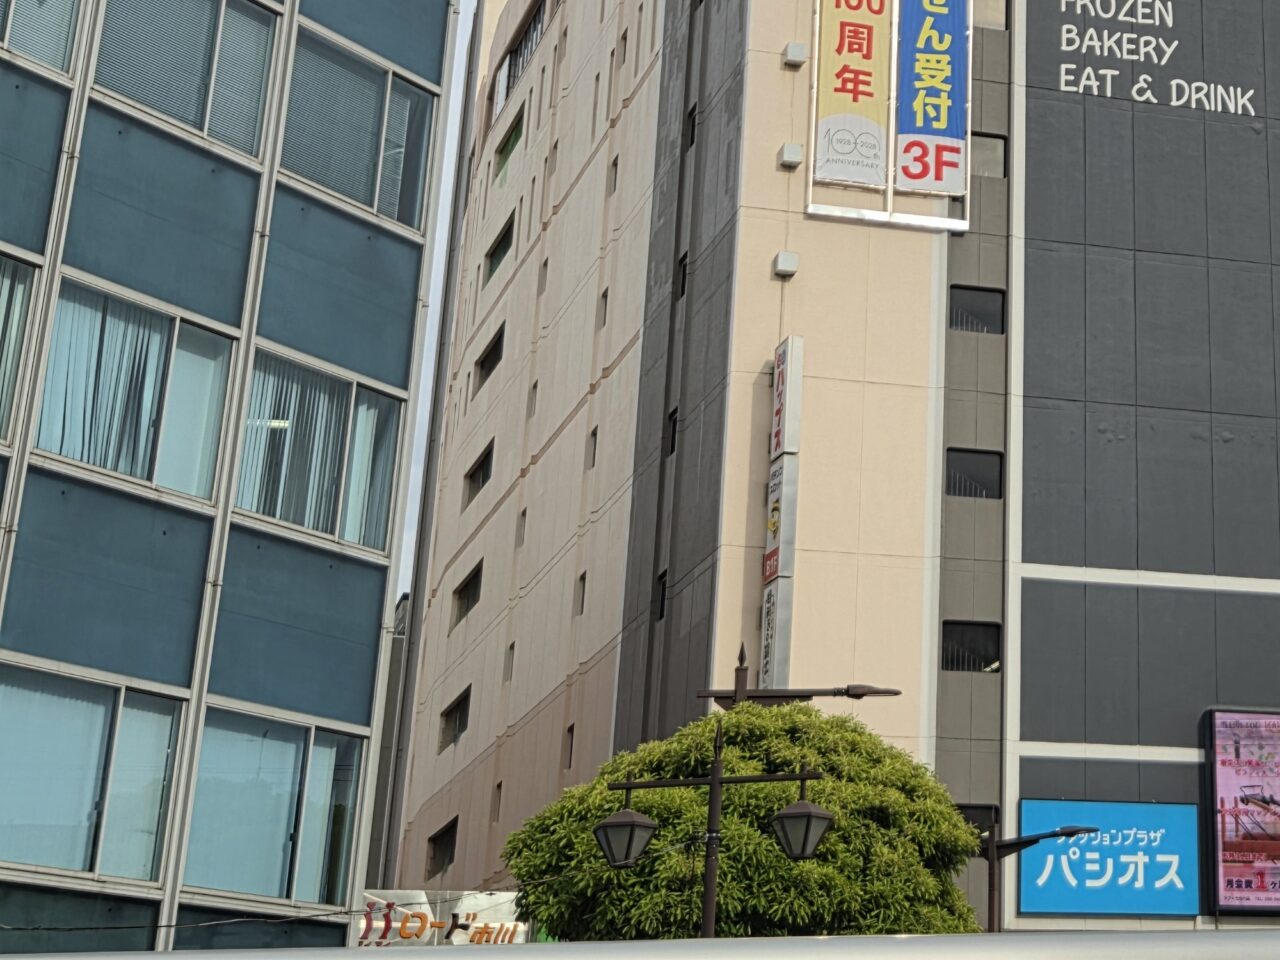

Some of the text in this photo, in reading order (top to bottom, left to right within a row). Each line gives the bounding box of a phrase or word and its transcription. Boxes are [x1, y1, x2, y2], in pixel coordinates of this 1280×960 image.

[1060, 24, 1179, 66] BAKERY
[1060, 64, 1256, 117] EAT & DRINK
[826, 157, 879, 169] ANNIVERSARY
[901, 141, 962, 182] 3F
[1036, 846, 1185, 888] パシオス
